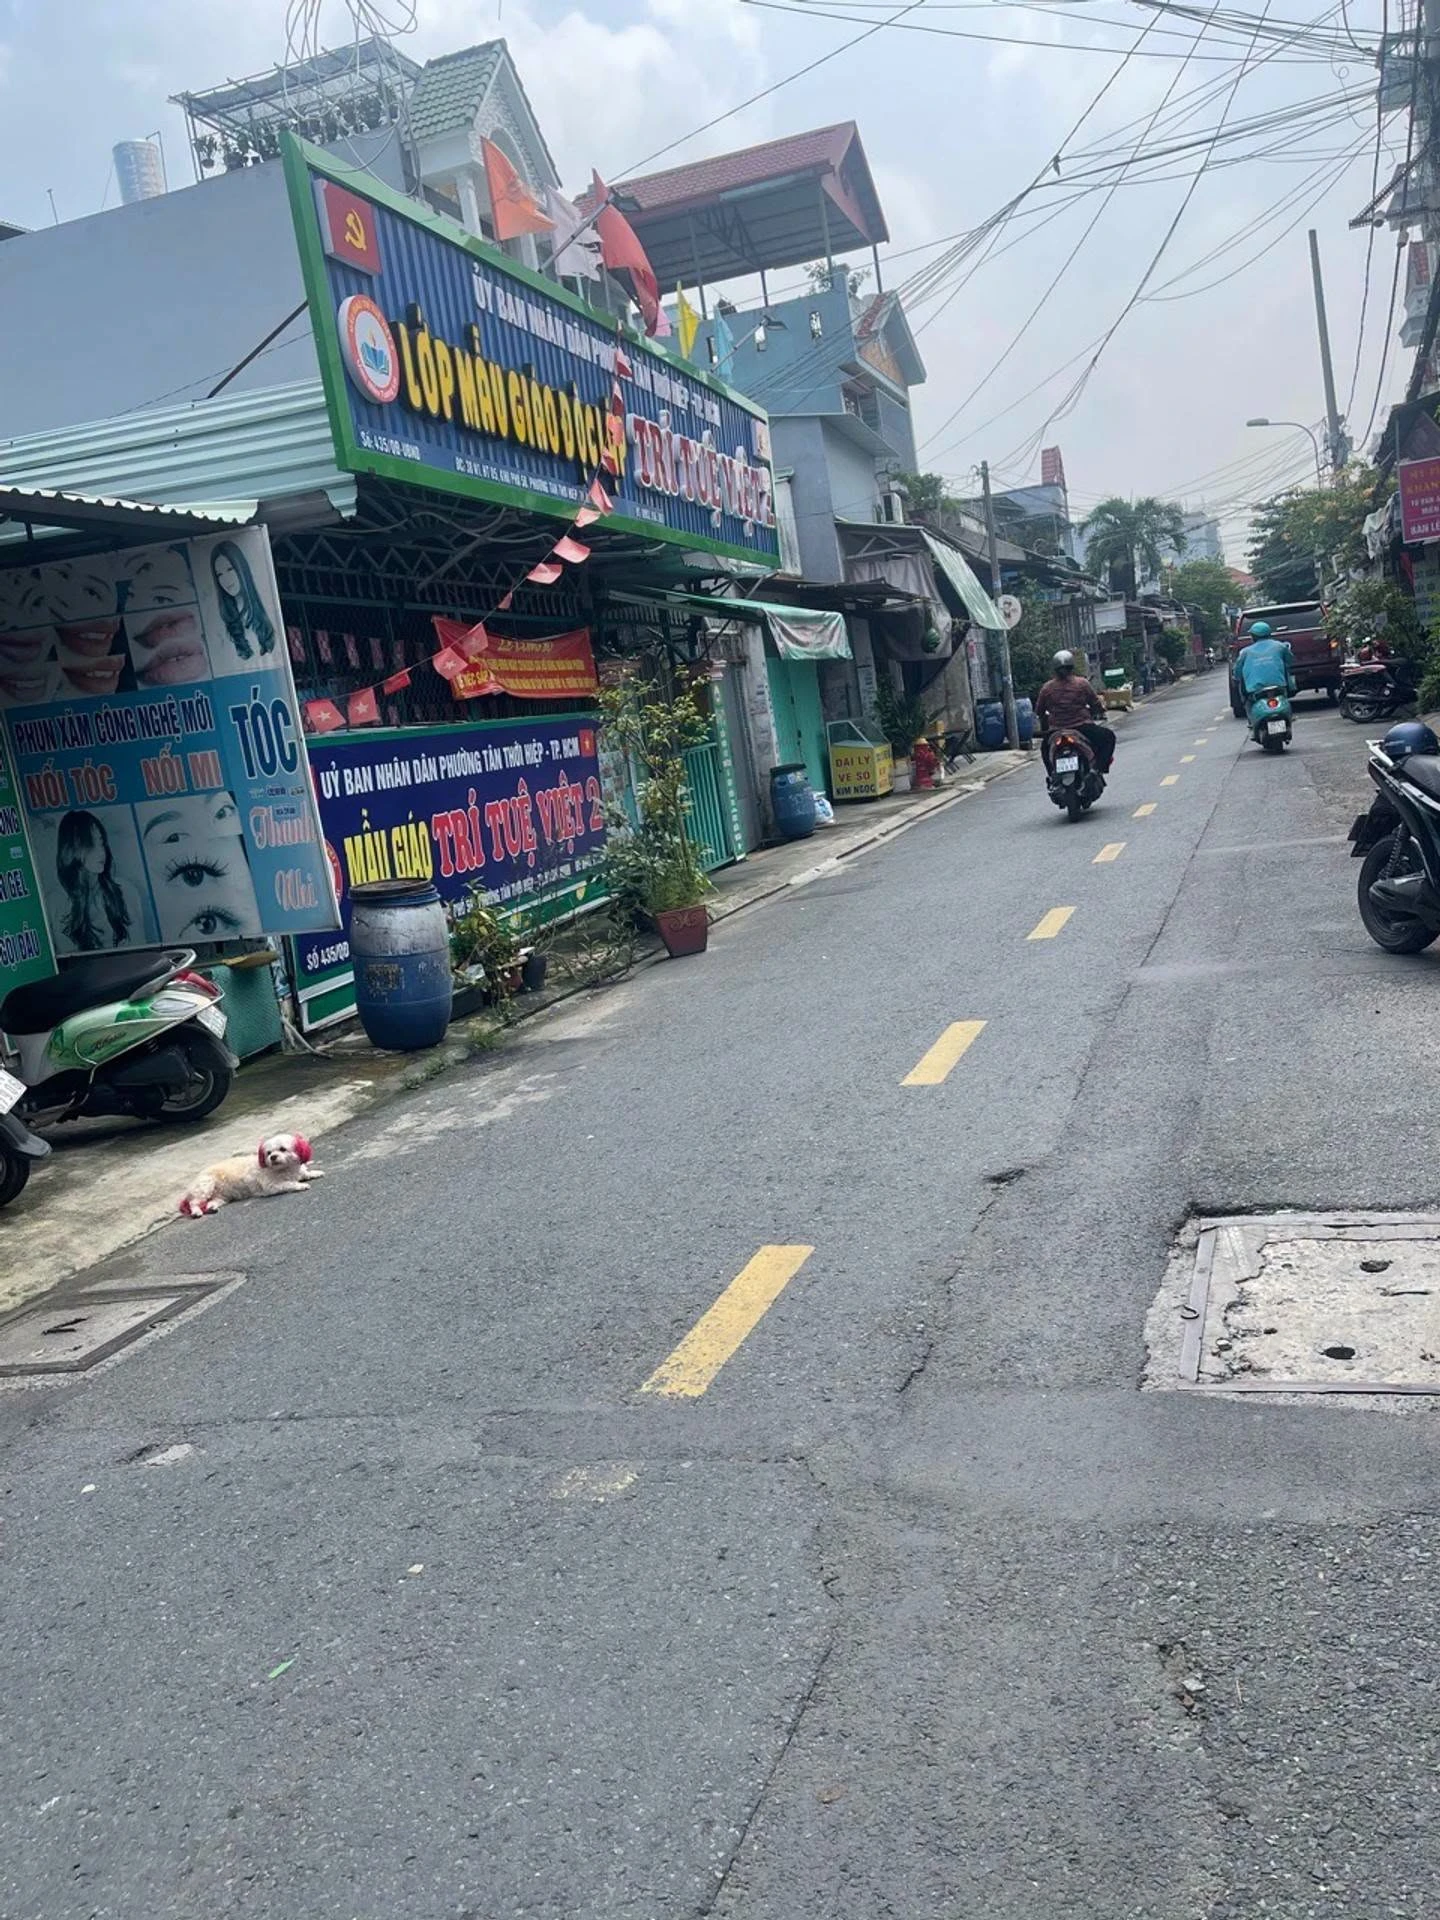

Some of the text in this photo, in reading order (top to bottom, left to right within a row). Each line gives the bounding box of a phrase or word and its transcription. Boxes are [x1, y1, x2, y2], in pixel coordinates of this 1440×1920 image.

[494, 285, 529, 332] BAN
[526, 301, 567, 351] NHÂN
[396, 304, 455, 420] LỚP
[507, 364, 560, 456] GIÁO
[14, 689, 216, 753] PHUN XĂM CÔNG NGHỆ MỚI
[228, 684, 301, 780] TÓC
[24, 757, 70, 809] NỐI
[69, 757, 119, 804] TÓC
[140, 742, 225, 797] NỐI MI
[343, 766, 375, 796] BAN
[375, 756, 413, 792] NHÂN
[412, 752, 440, 786] DÂN
[439, 746, 484, 781] PHƯỜNG
[481, 743, 504, 774] TÂN
[390, 809, 434, 881] GIÁO
[431, 787, 487, 879] TRÍ
[484, 775, 538, 869] TUỆ
[534, 767, 586, 856] VIỆT
[585, 774, 605, 832] 2
[306, 944, 320, 971] SỐ
